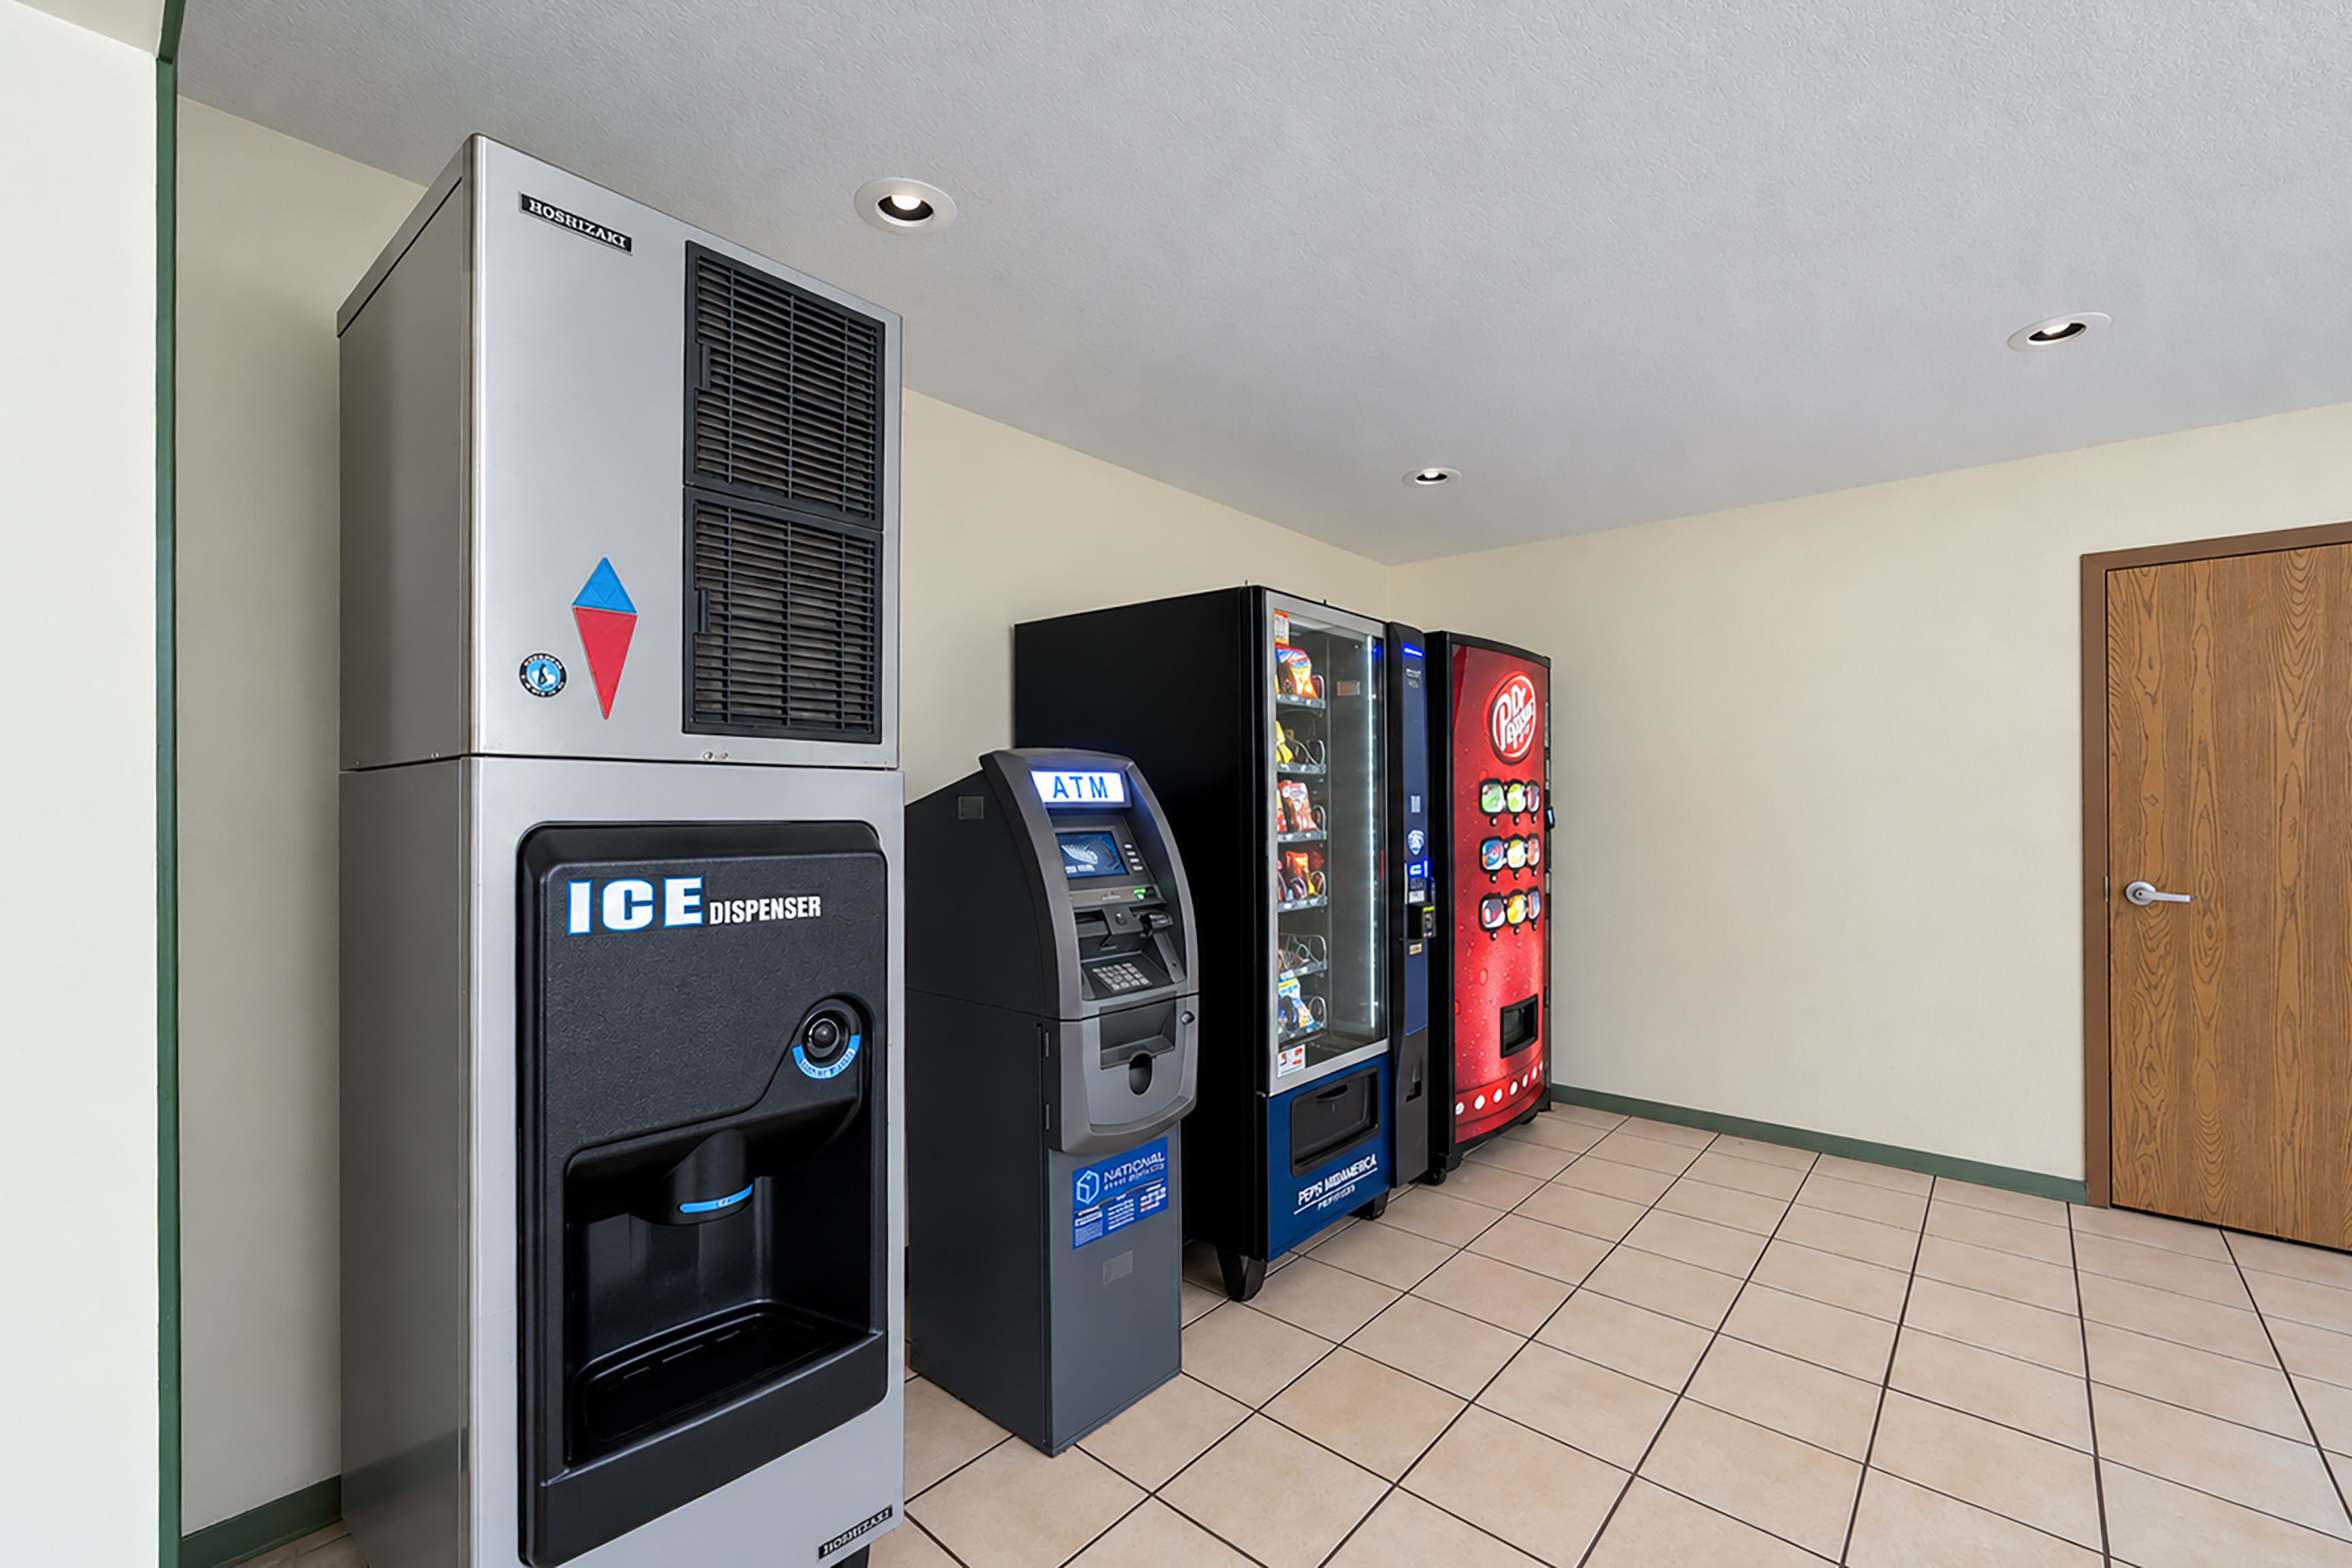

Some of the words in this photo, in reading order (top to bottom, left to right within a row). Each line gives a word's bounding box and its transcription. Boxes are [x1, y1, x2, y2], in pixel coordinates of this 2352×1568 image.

[528, 198, 626, 248] HOSHIZAKI
[1511, 684, 1526, 717] Dr
[1053, 775, 1109, 799] ATM
[567, 876, 704, 936] ICE
[709, 896, 821, 925] DISPENSER
[1103, 1152, 1166, 1183] NATIONAL
